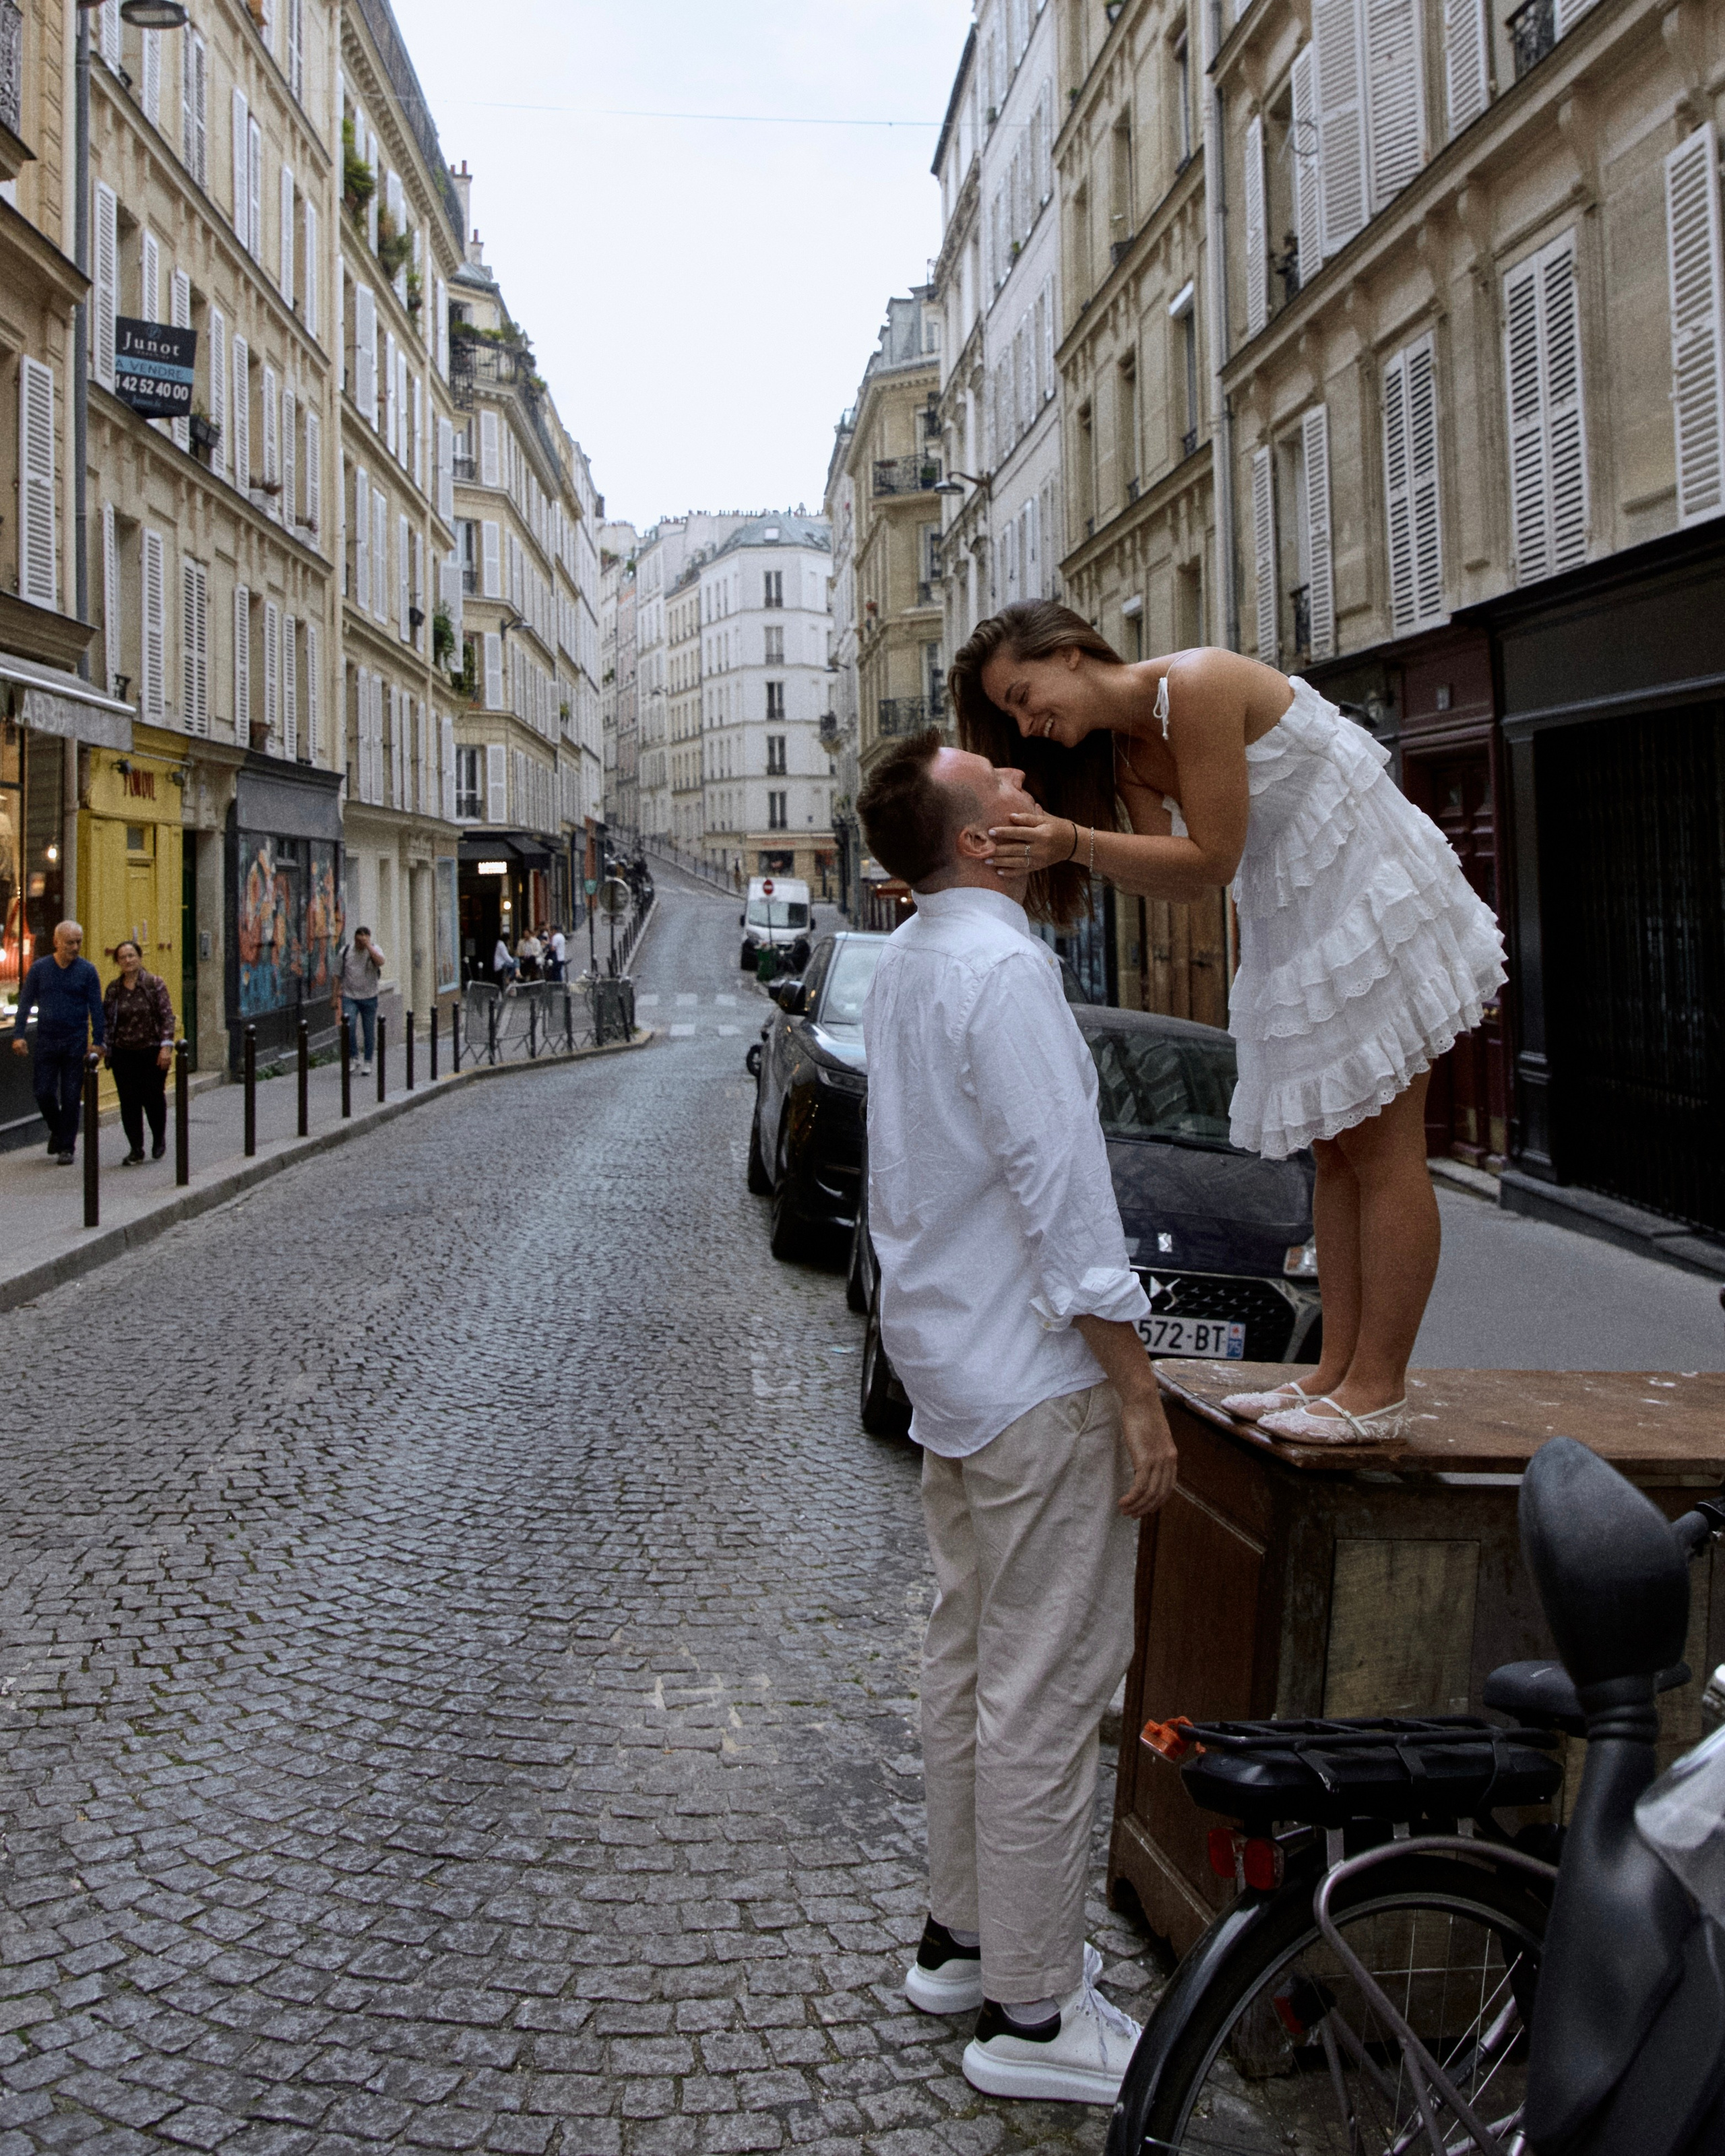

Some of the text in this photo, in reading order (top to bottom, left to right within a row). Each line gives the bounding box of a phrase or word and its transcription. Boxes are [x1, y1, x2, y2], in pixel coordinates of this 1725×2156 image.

[123, 331, 180, 356] Junot
[129, 360, 184, 379] VENDRE
[122, 376, 137, 391] 42
[139, 378, 154, 395] 52
[156, 382, 171, 398] 40
[173, 385, 189, 401] 00
[1228, 1340, 1242, 1354] 75
